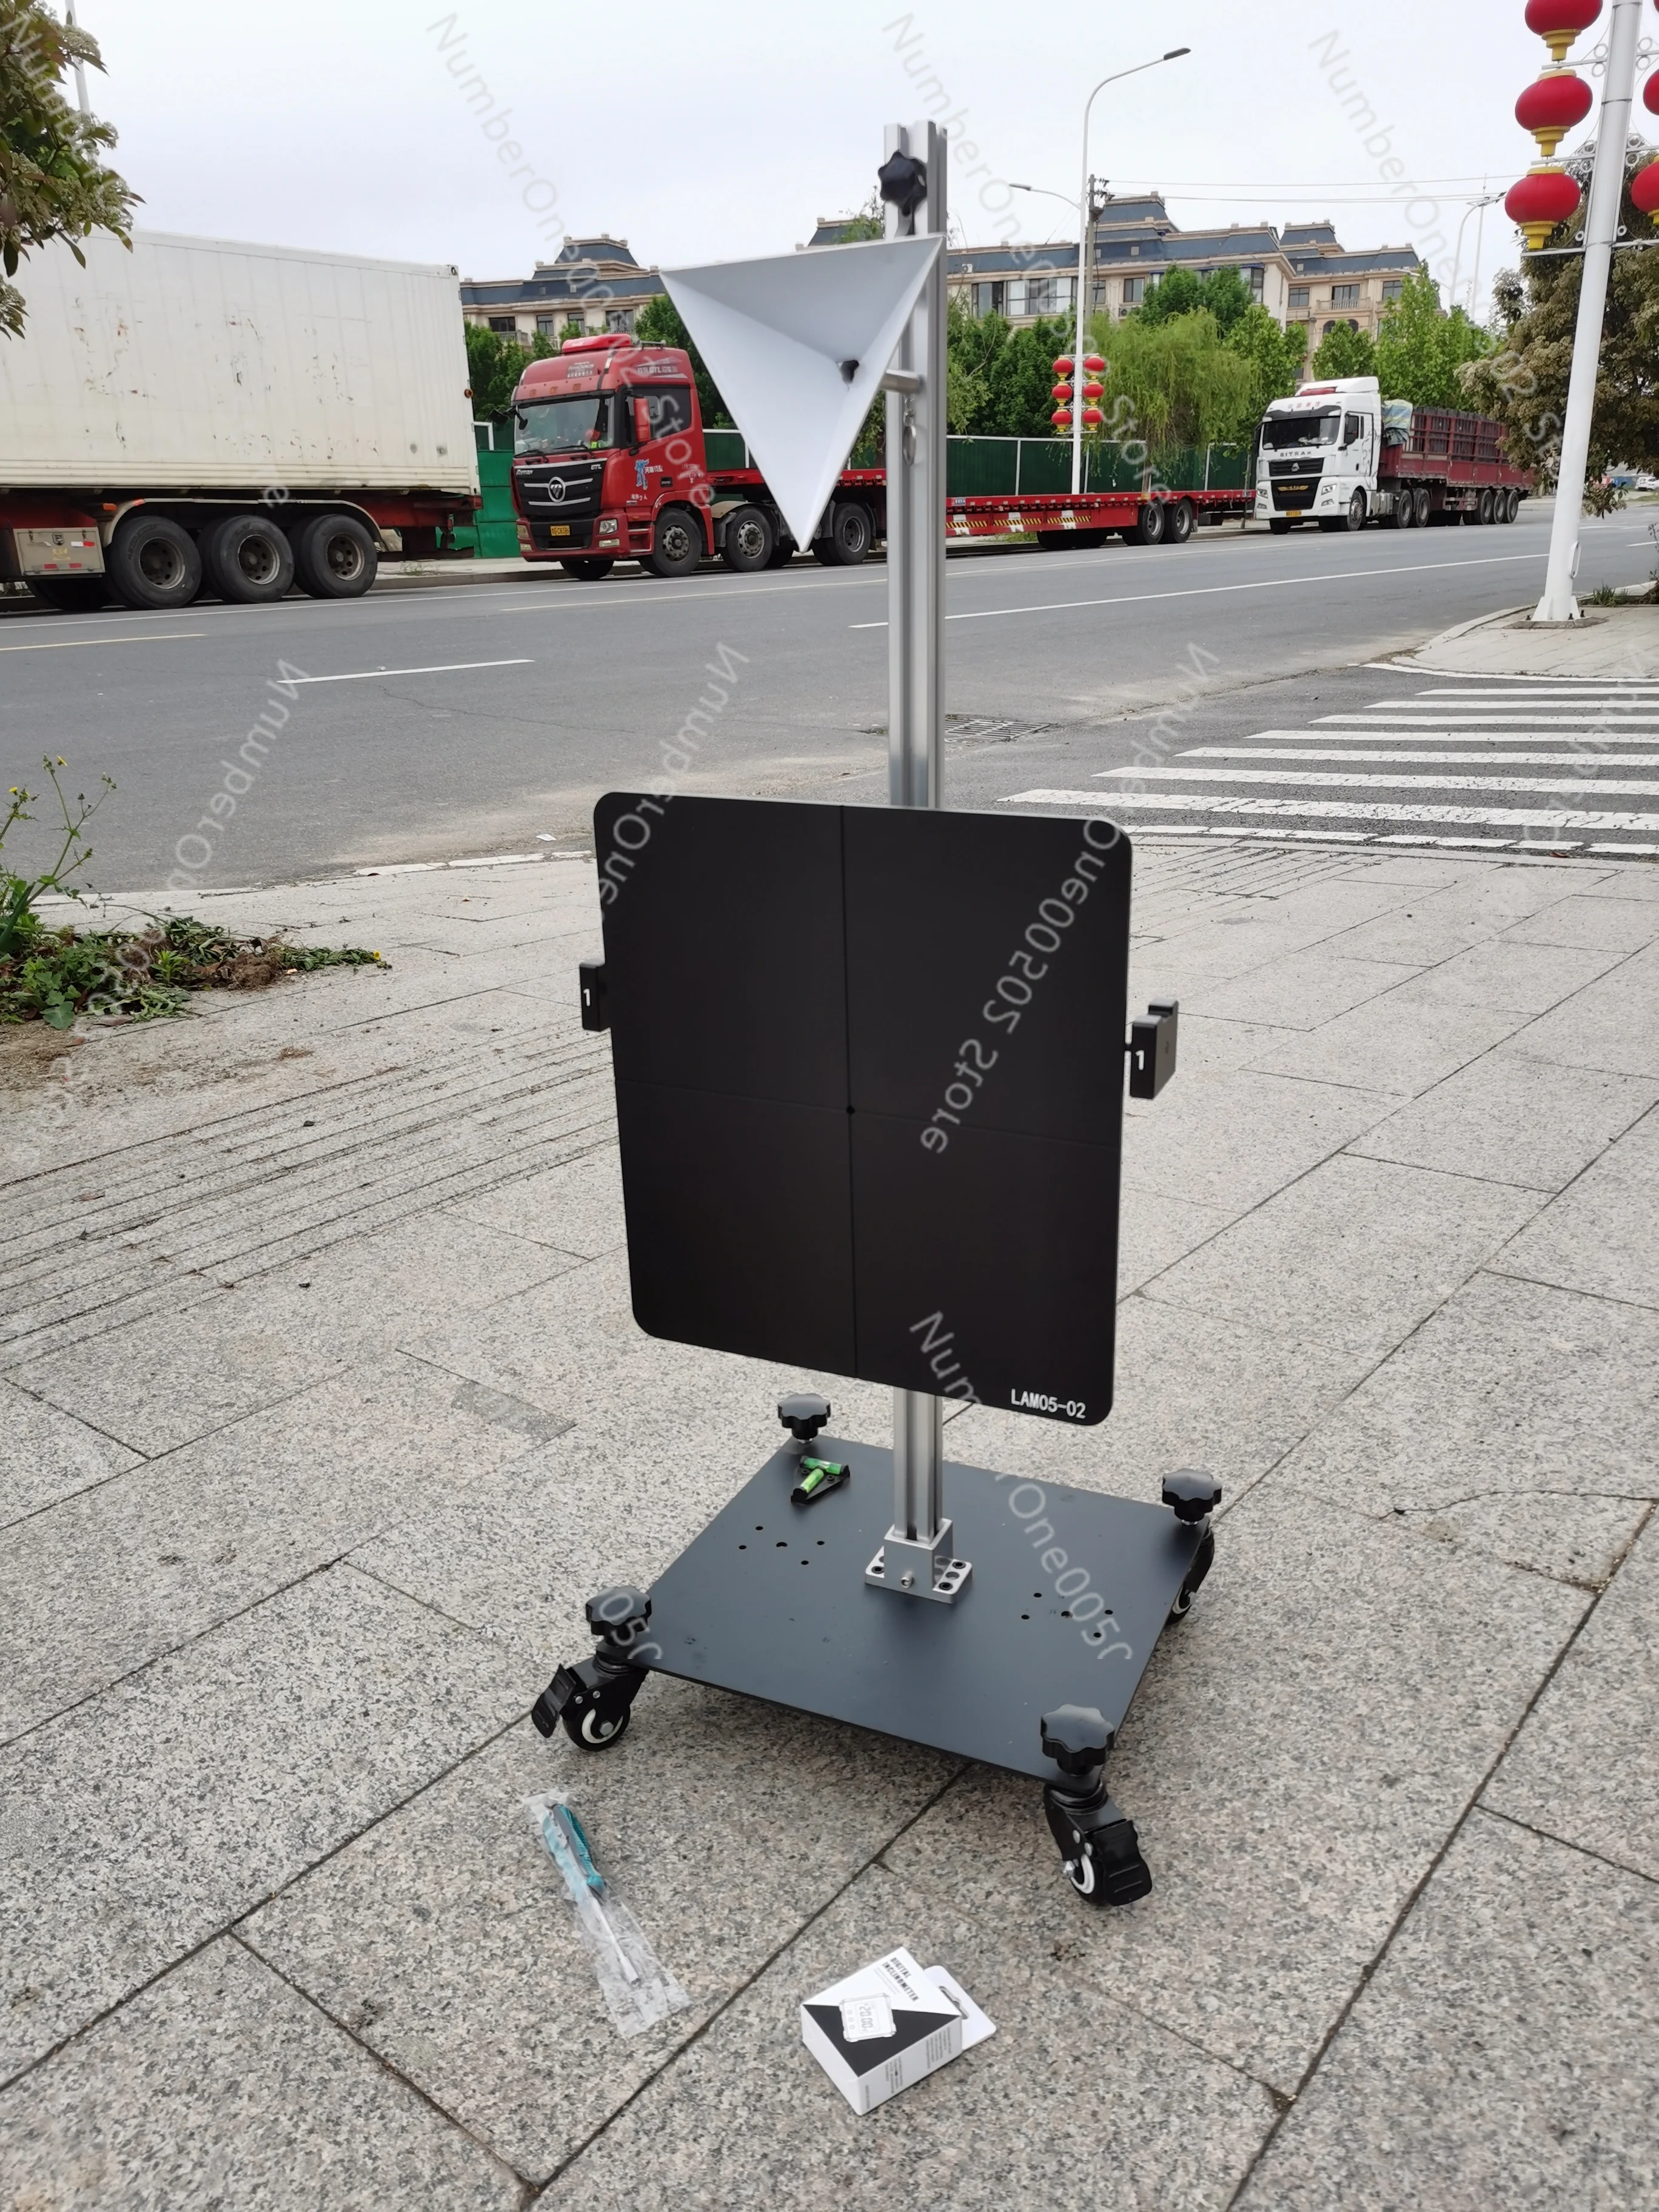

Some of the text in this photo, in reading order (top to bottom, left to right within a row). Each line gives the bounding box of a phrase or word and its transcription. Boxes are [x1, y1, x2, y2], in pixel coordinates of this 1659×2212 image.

[583, 988, 591, 1007] 1
[1135, 1050, 1145, 1070] 1
[1011, 1388, 1087, 1419] LAM05-02
[890, 1957, 912, 1979] DIGITAL
[882, 1962, 920, 2002] INCLINOMETER
